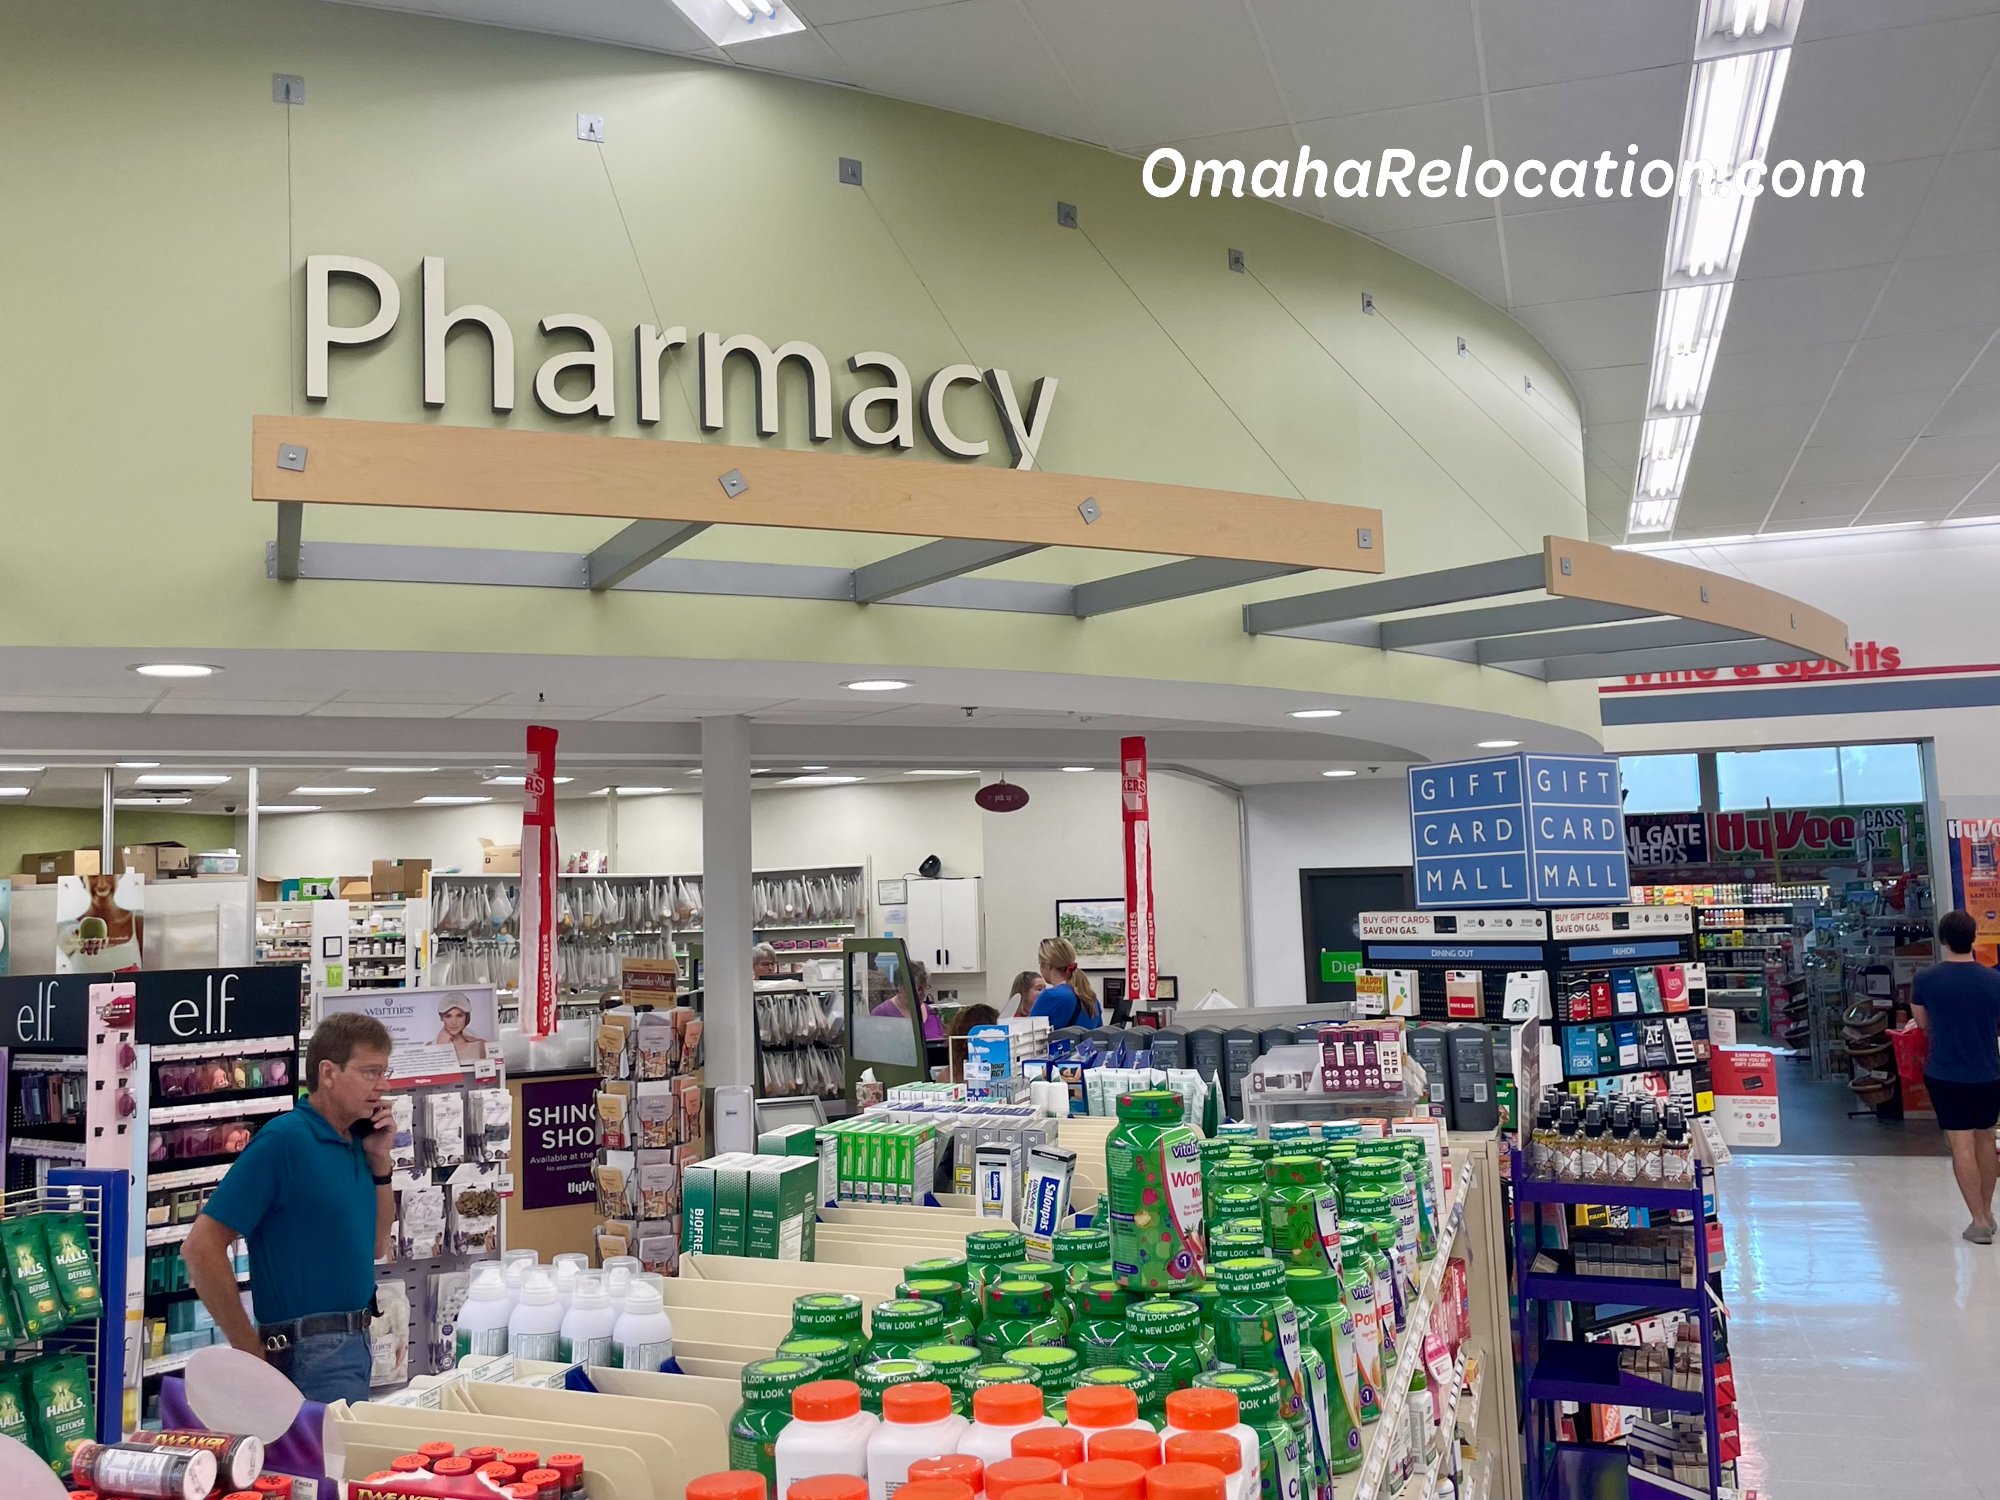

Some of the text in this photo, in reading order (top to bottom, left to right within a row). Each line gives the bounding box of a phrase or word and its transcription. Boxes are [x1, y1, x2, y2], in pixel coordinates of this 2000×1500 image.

[304, 254, 1060, 470] Pharmacy
[1420, 770, 1507, 800] GIFT
[1536, 769, 1609, 793] GIFT
[1863, 808, 1904, 828] CASS
[1424, 818, 1513, 846] CARD
[1541, 817, 1616, 841] CARD
[1715, 810, 1856, 860] HyVee
[1427, 866, 1513, 892] MALL
[1544, 864, 1617, 888] MALL
[1363, 916, 1378, 924] BUY
[1381, 916, 1399, 924] GIFT
[1555, 914, 1570, 923] BUY
[1571, 913, 1586, 922] GIFT
[1363, 926, 1419, 935] SAVE ON GAS.
[1556, 924, 1573, 934] SAVE
[1574, 924, 1584, 933] ON
[1129, 912, 1140, 991] GO HUSKERS
[1612, 947, 1635, 956] FASHION
[365, 1004, 415, 1016] warmies
[542, 1126, 595, 1149] SHO
[530, 1154, 567, 1164] Available
[580, 1151, 593, 1159] the
[1039, 1181, 1056, 1231] Salonpas
[1095, 1241, 1109, 1249] LOOK
[56, 1250, 89, 1266] HALLS
[68, 1268, 92, 1280] DEFENSE
[1235, 1268, 1277, 1281] LOOK NEW
[1251, 1281, 1271, 1290] LOOK
[801, 1314, 813, 1323] NEW
[815, 1314, 836, 1323] LOOK
[1147, 1313, 1168, 1321] LOOK
[878, 1318, 939, 1330] NEW LOOK NEW
[1145, 1323, 1185, 1334] NEW LOOK
[945, 1367, 963, 1375] LOOK
[1045, 1368, 1063, 1376] LOOK
[776, 1374, 796, 1382] NEW
[888, 1374, 911, 1382] LOOK
[746, 1388, 784, 1399] NEW LOOK
[56, 1417, 86, 1434] DEFENSE
[154, 1434, 225, 1449] TWEAKER
